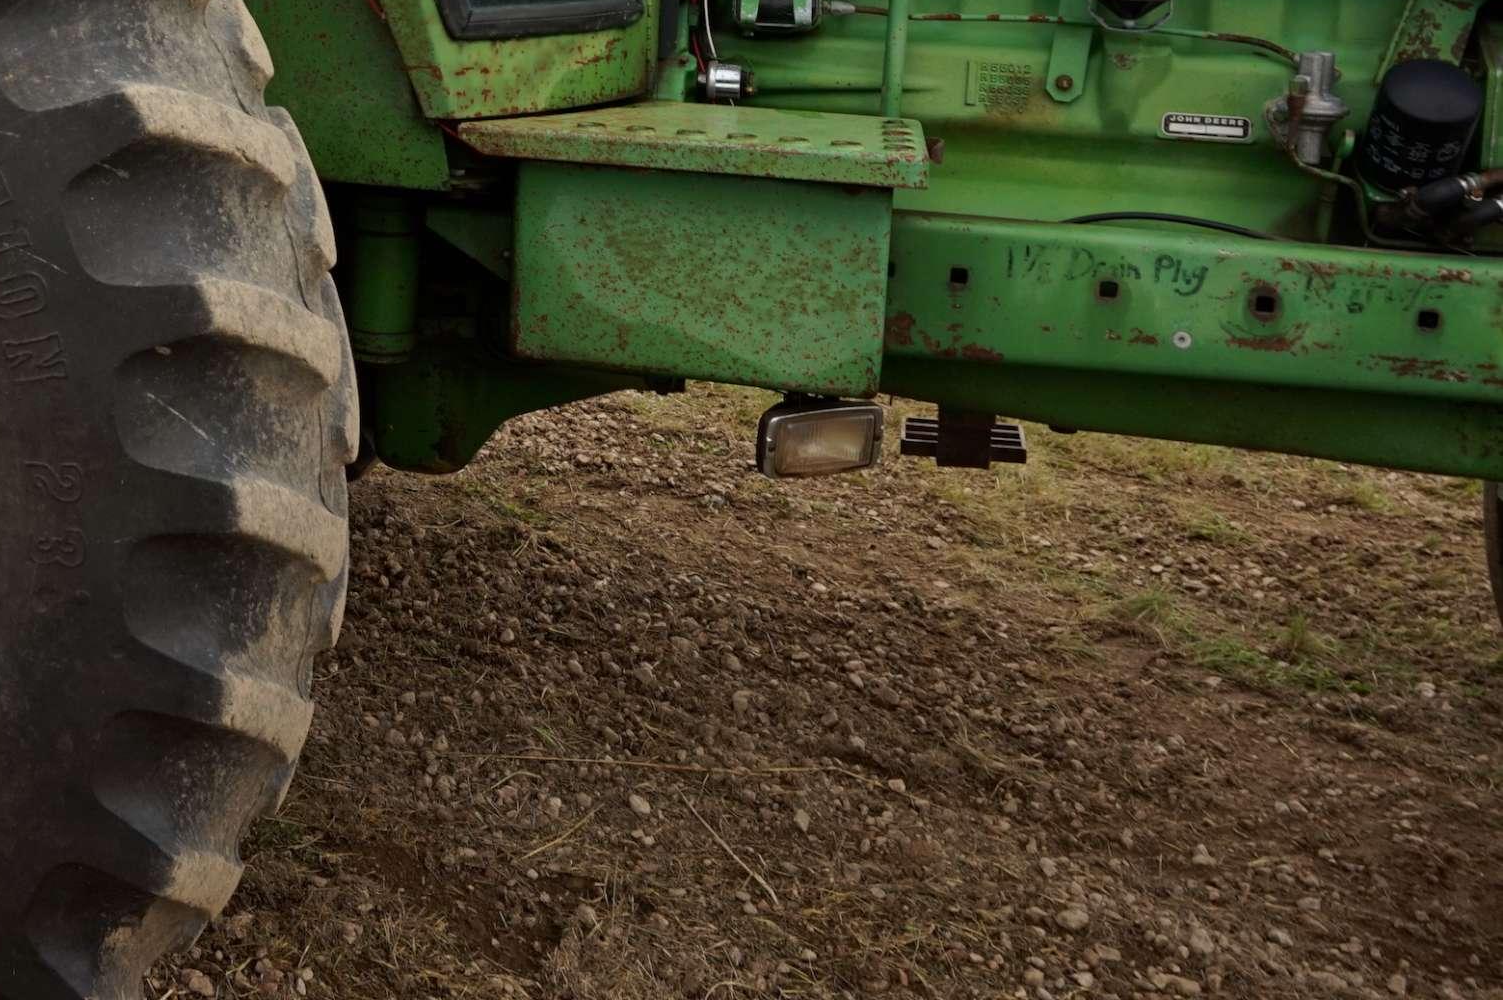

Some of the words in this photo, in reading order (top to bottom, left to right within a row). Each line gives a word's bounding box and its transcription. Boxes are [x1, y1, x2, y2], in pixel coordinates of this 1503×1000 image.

[1169, 114, 1201, 124] JOHN
[1204, 117, 1245, 127] DEERE
[1065, 247, 1142, 281] Drain
[1153, 253, 1210, 298] Plug
